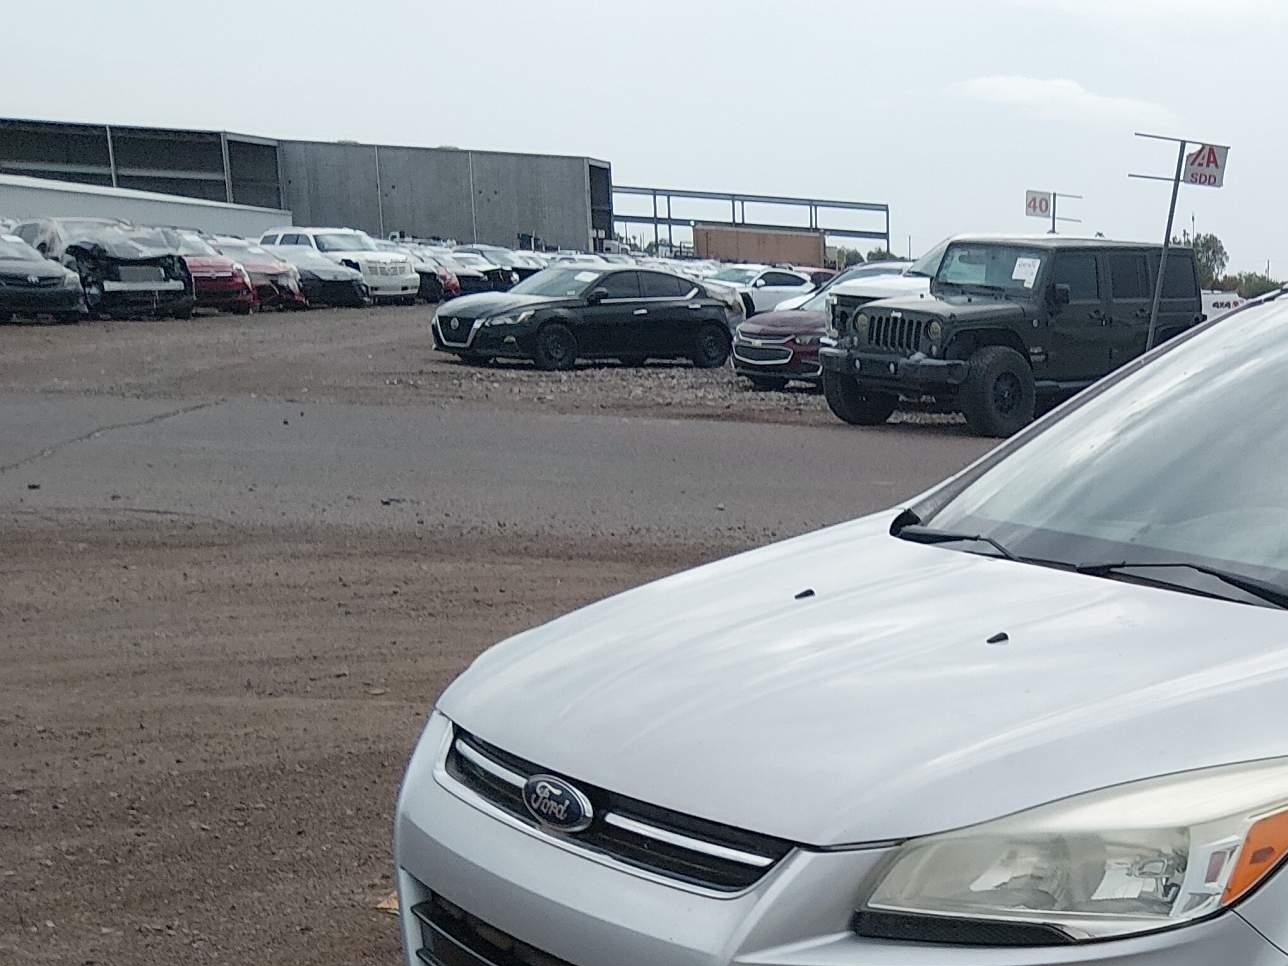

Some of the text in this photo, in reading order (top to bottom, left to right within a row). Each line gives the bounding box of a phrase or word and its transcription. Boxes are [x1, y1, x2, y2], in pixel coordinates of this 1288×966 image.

[1190, 172, 1217, 186] SDD
[1027, 196, 1049, 214] 40
[531, 781, 570, 820] Ford
